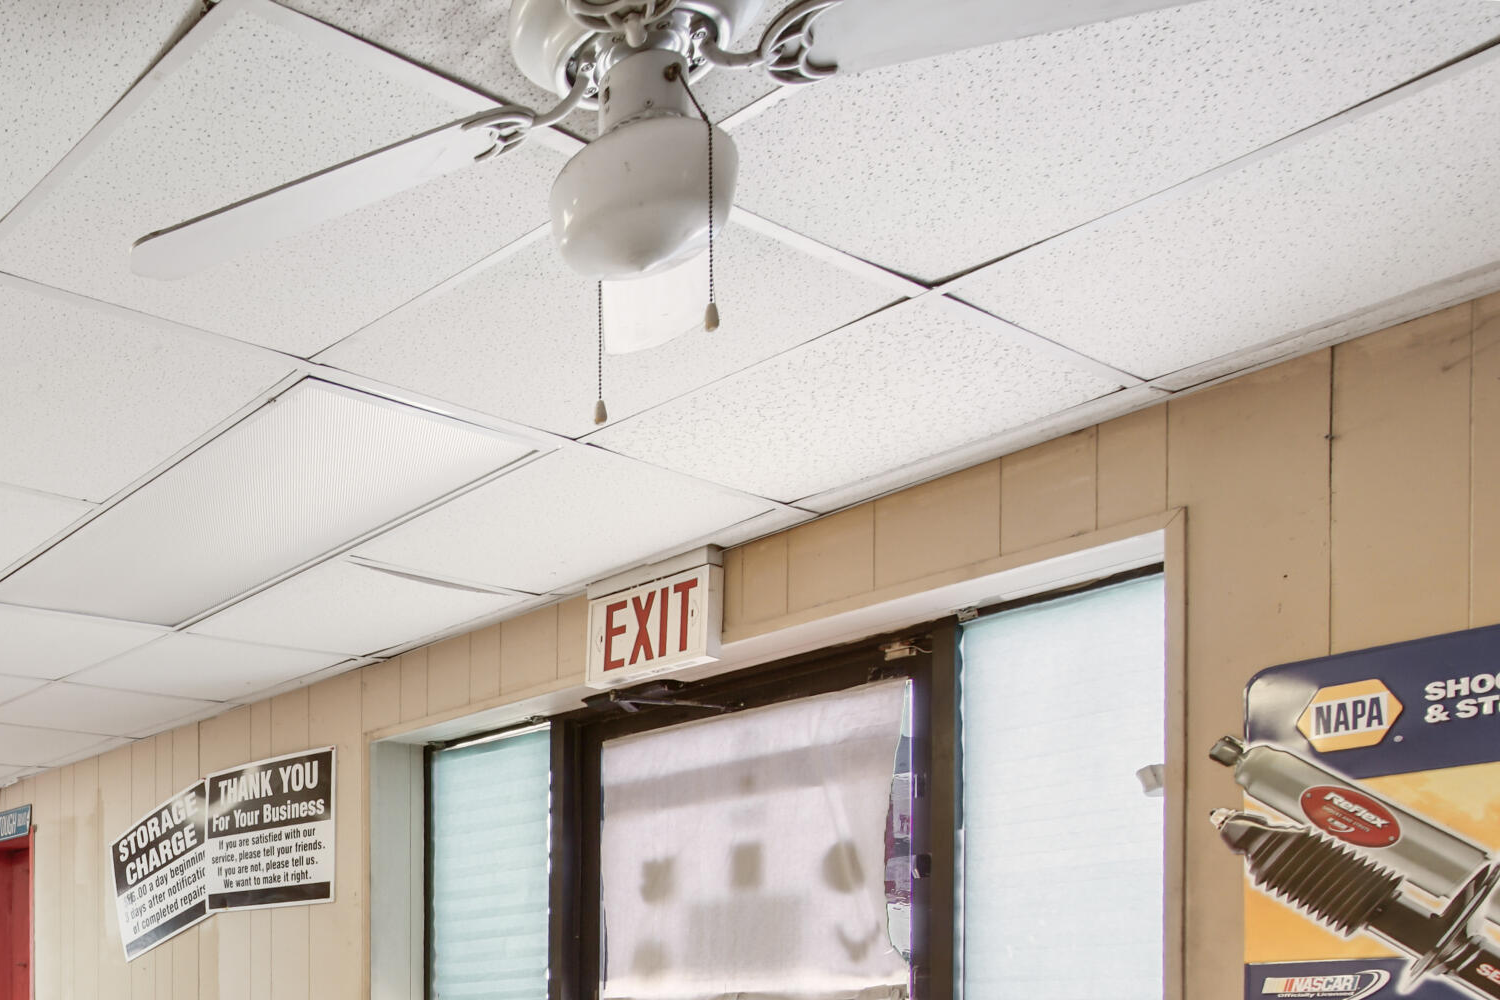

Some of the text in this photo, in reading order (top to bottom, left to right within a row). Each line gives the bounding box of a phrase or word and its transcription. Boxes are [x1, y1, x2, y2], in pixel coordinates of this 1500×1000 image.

[603, 577, 698, 672] EXIT
[1424, 672, 1500, 701] SHO
[1314, 696, 1384, 736] NAPA
[1424, 694, 1500, 724] & ST
[218, 760, 319, 806] THANK YOU
[118, 791, 198, 863] STORAGE
[212, 798, 325, 832] For Your Business
[212, 840, 326, 865] service, please tell your friends.
[218, 827, 316, 851] If you are satisfied with our
[125, 823, 198, 885] CHARGE
[217, 866, 223, 877] If
[224, 867, 236, 877] you
[237, 866, 249, 874] are
[266, 859, 290, 873] please
[291, 855, 304, 867] tell
[305, 856, 318, 865] us.
[149, 882, 154, 892] a
[155, 872, 168, 889] day
[223, 870, 312, 889] We want to make it right.
[131, 903, 147, 919] days
[148, 891, 166, 909] after
[141, 900, 179, 928] completed
[1291, 975, 1354, 993] NASCAR
